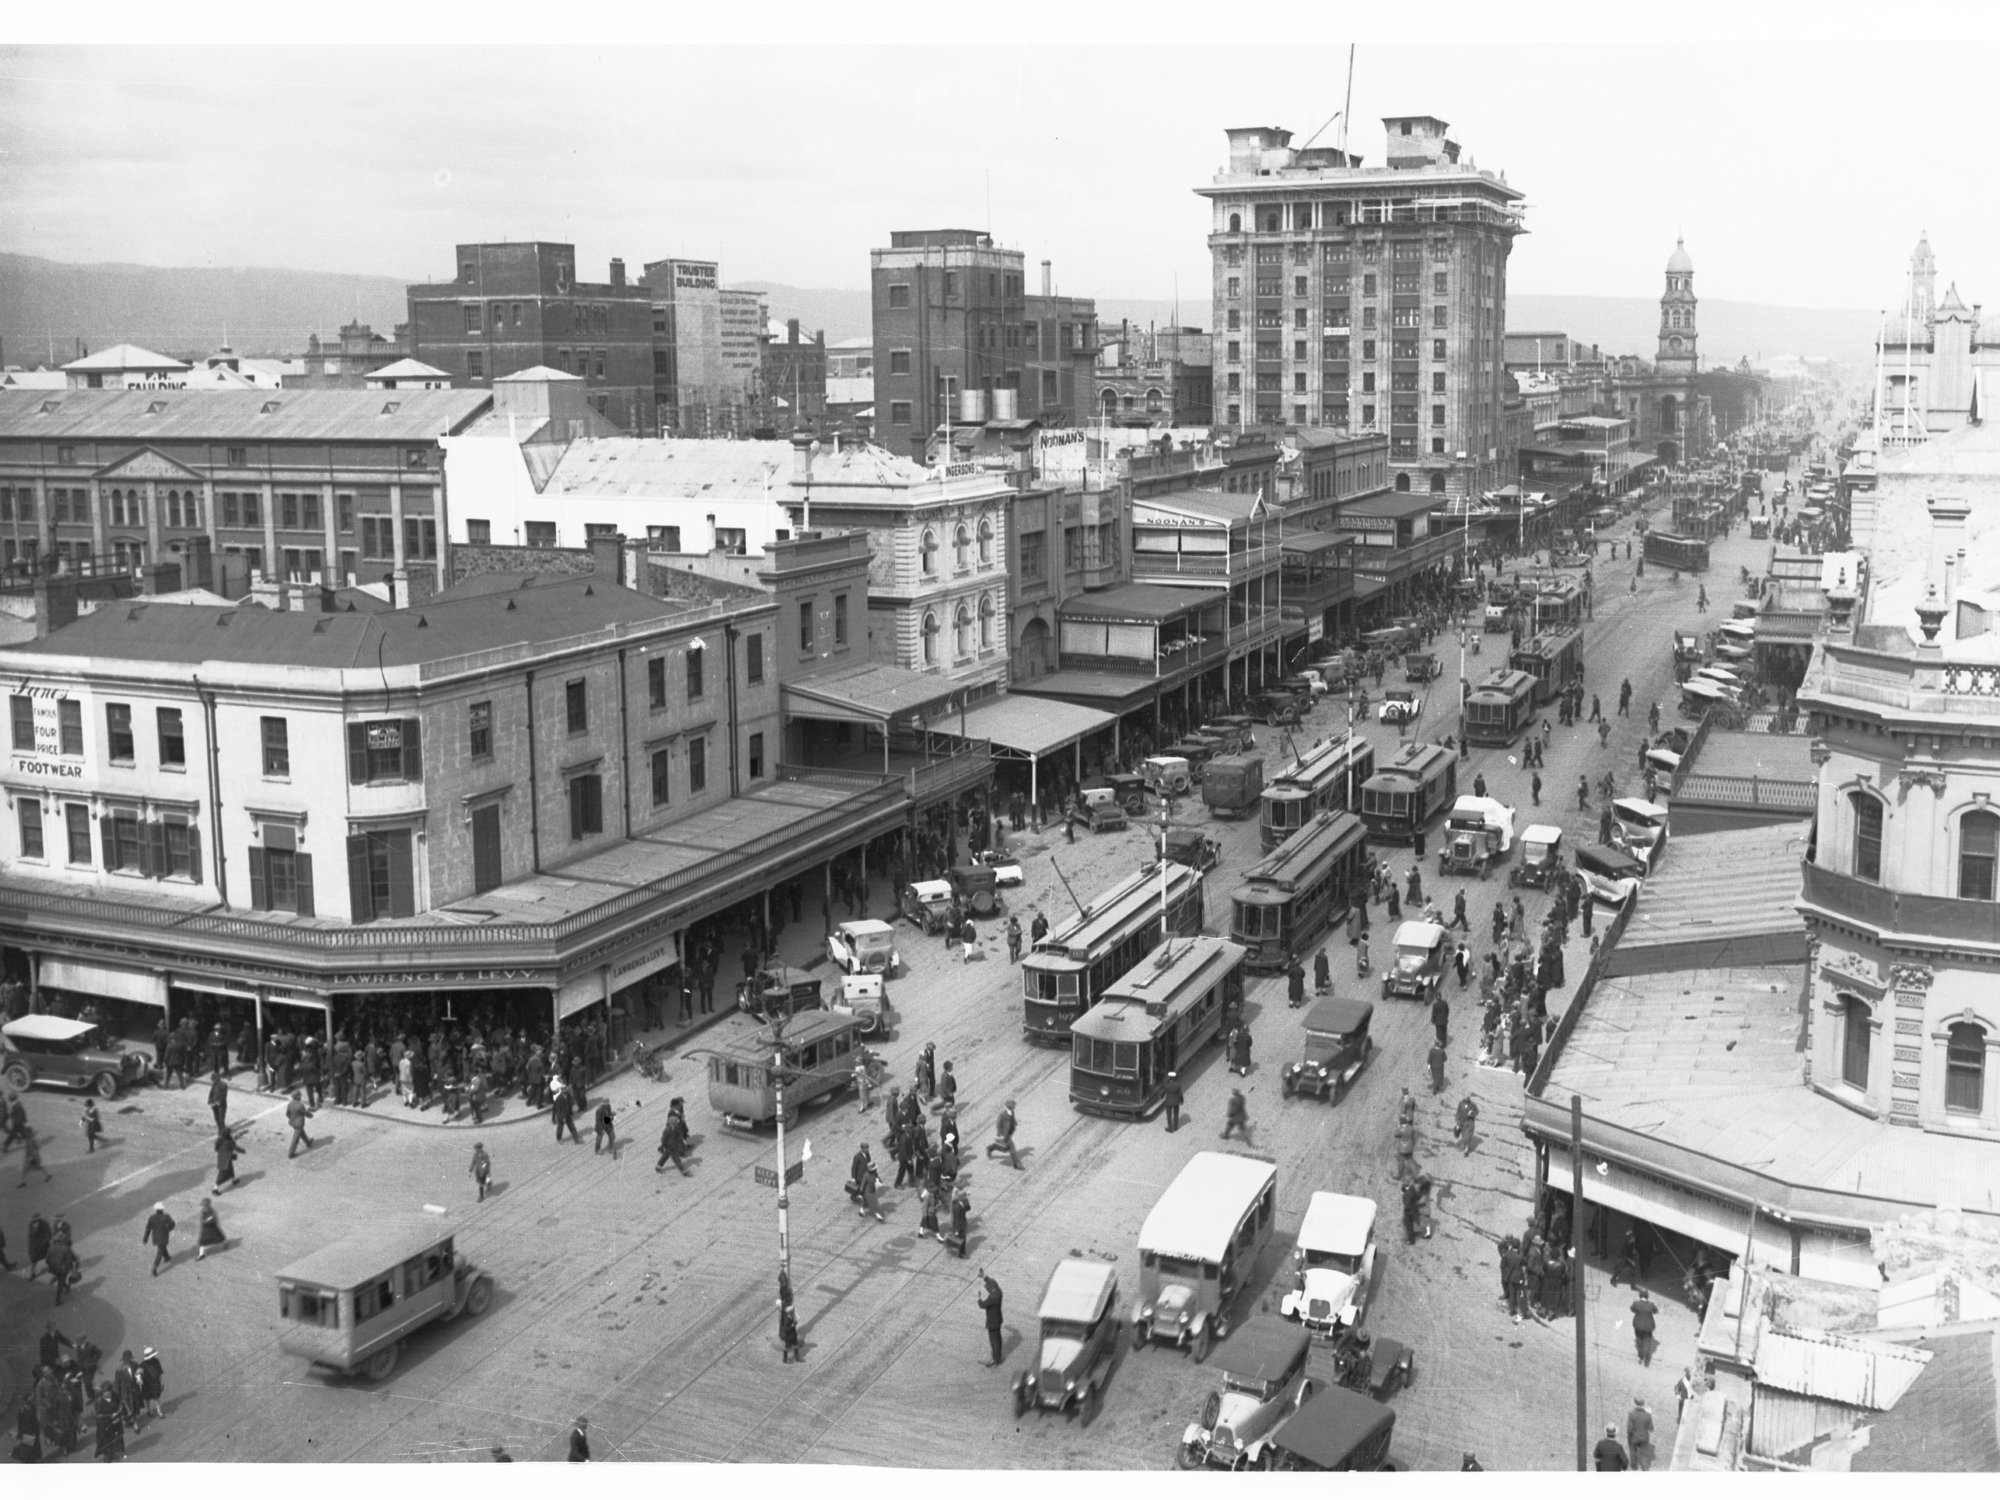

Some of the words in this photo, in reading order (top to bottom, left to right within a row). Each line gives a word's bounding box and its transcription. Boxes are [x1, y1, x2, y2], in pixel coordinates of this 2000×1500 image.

[677, 264, 716, 277] TRUSTEE
[36, 726, 57, 738] FOUR
[37, 744, 58, 756] PRICE
[19, 760, 82, 778] FOOTWEAR
[334, 972, 445, 984] LAWRENCE
[456, 971, 465, 981] &
[1058, 1012, 1075, 1021] 107
